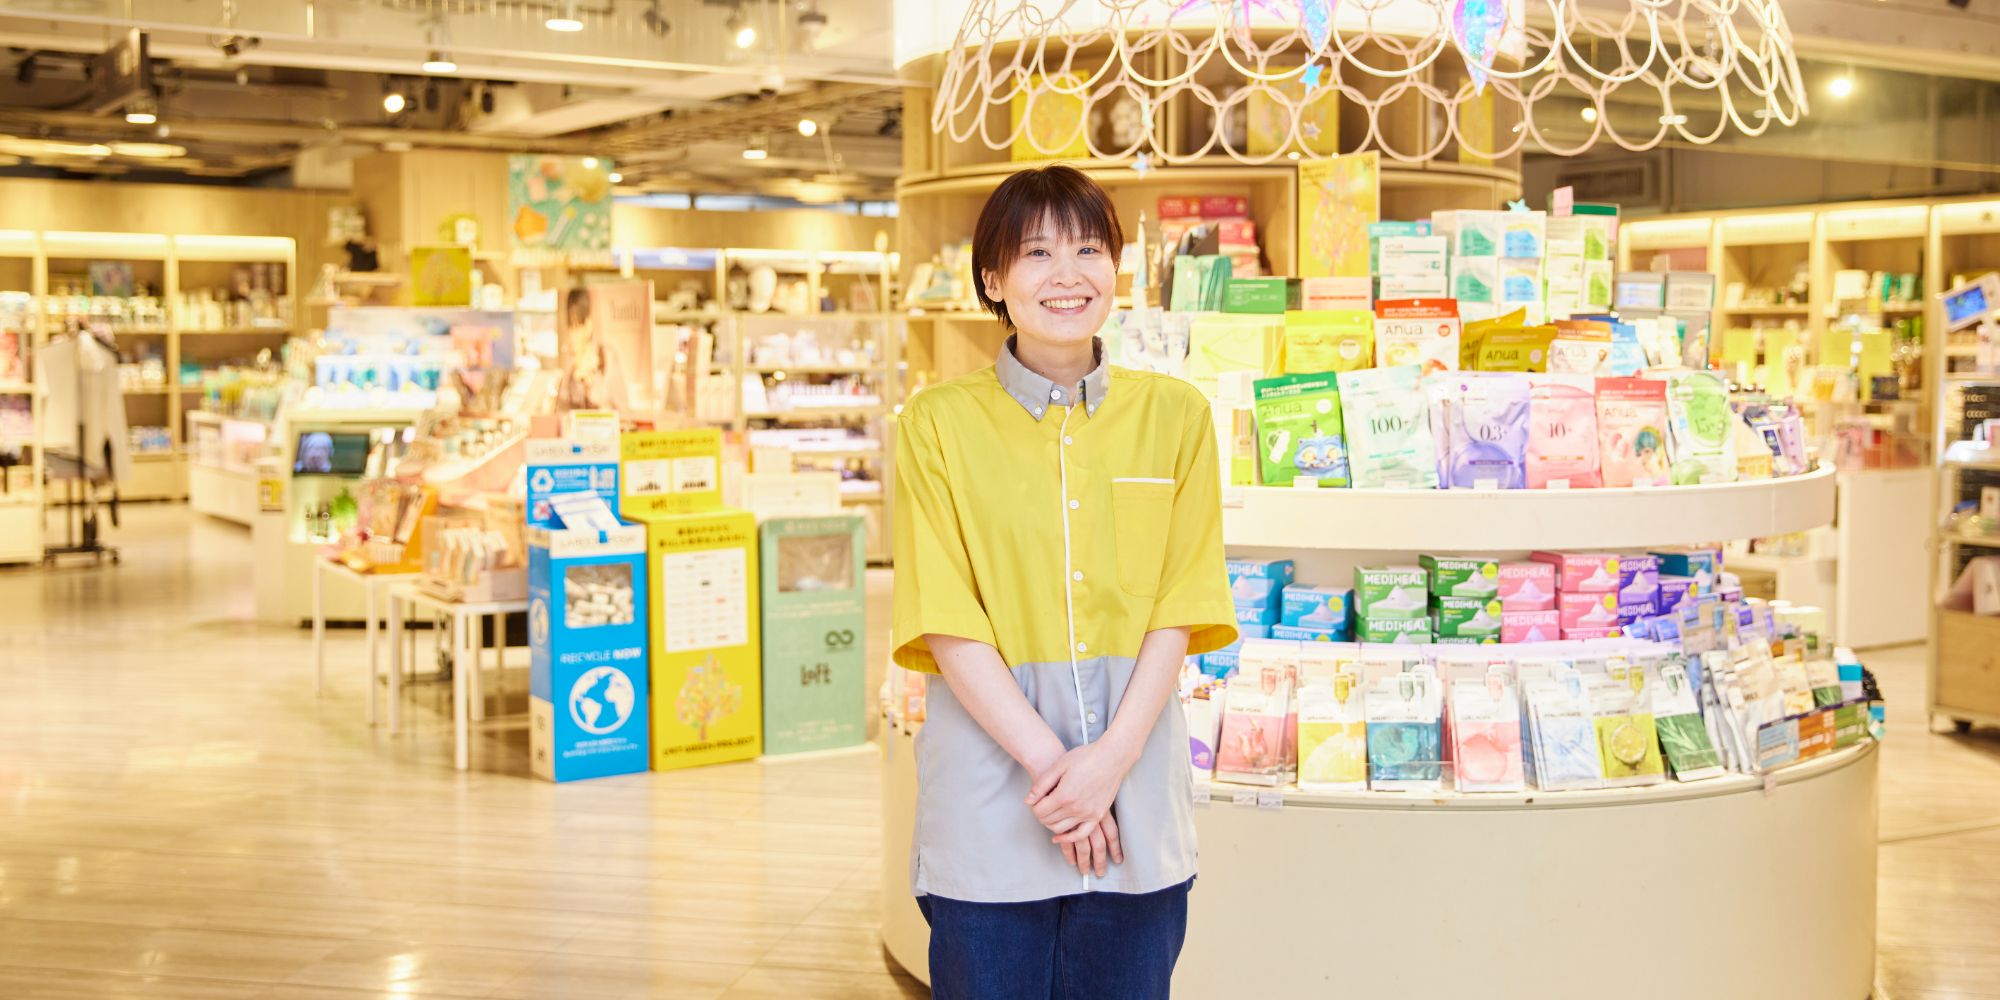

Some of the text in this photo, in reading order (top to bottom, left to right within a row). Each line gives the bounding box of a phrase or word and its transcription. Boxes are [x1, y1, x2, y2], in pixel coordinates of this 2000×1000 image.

[1385, 325, 1423, 336] Anua
[1486, 347, 1519, 361] Anua
[1263, 402, 1302, 417] Anua
[1437, 561, 1479, 570] MEDIHEAL
[1565, 558, 1601, 566] MEDIHEAL
[1227, 563, 1265, 577] DIHEAL
[1498, 567, 1552, 578] MEDIHEAL
[1364, 574, 1424, 585] MEDIHEAL
[1284, 591, 1324, 603] MEDIHEAL
[1443, 600, 1484, 609] MEDIHEAL
[1369, 620, 1429, 631] MEDIHEAL
[1503, 614, 1557, 626] MEDIHEAL
[560, 646, 641, 664] RECYCLE NOW
[1203, 654, 1239, 666] MEDIH
